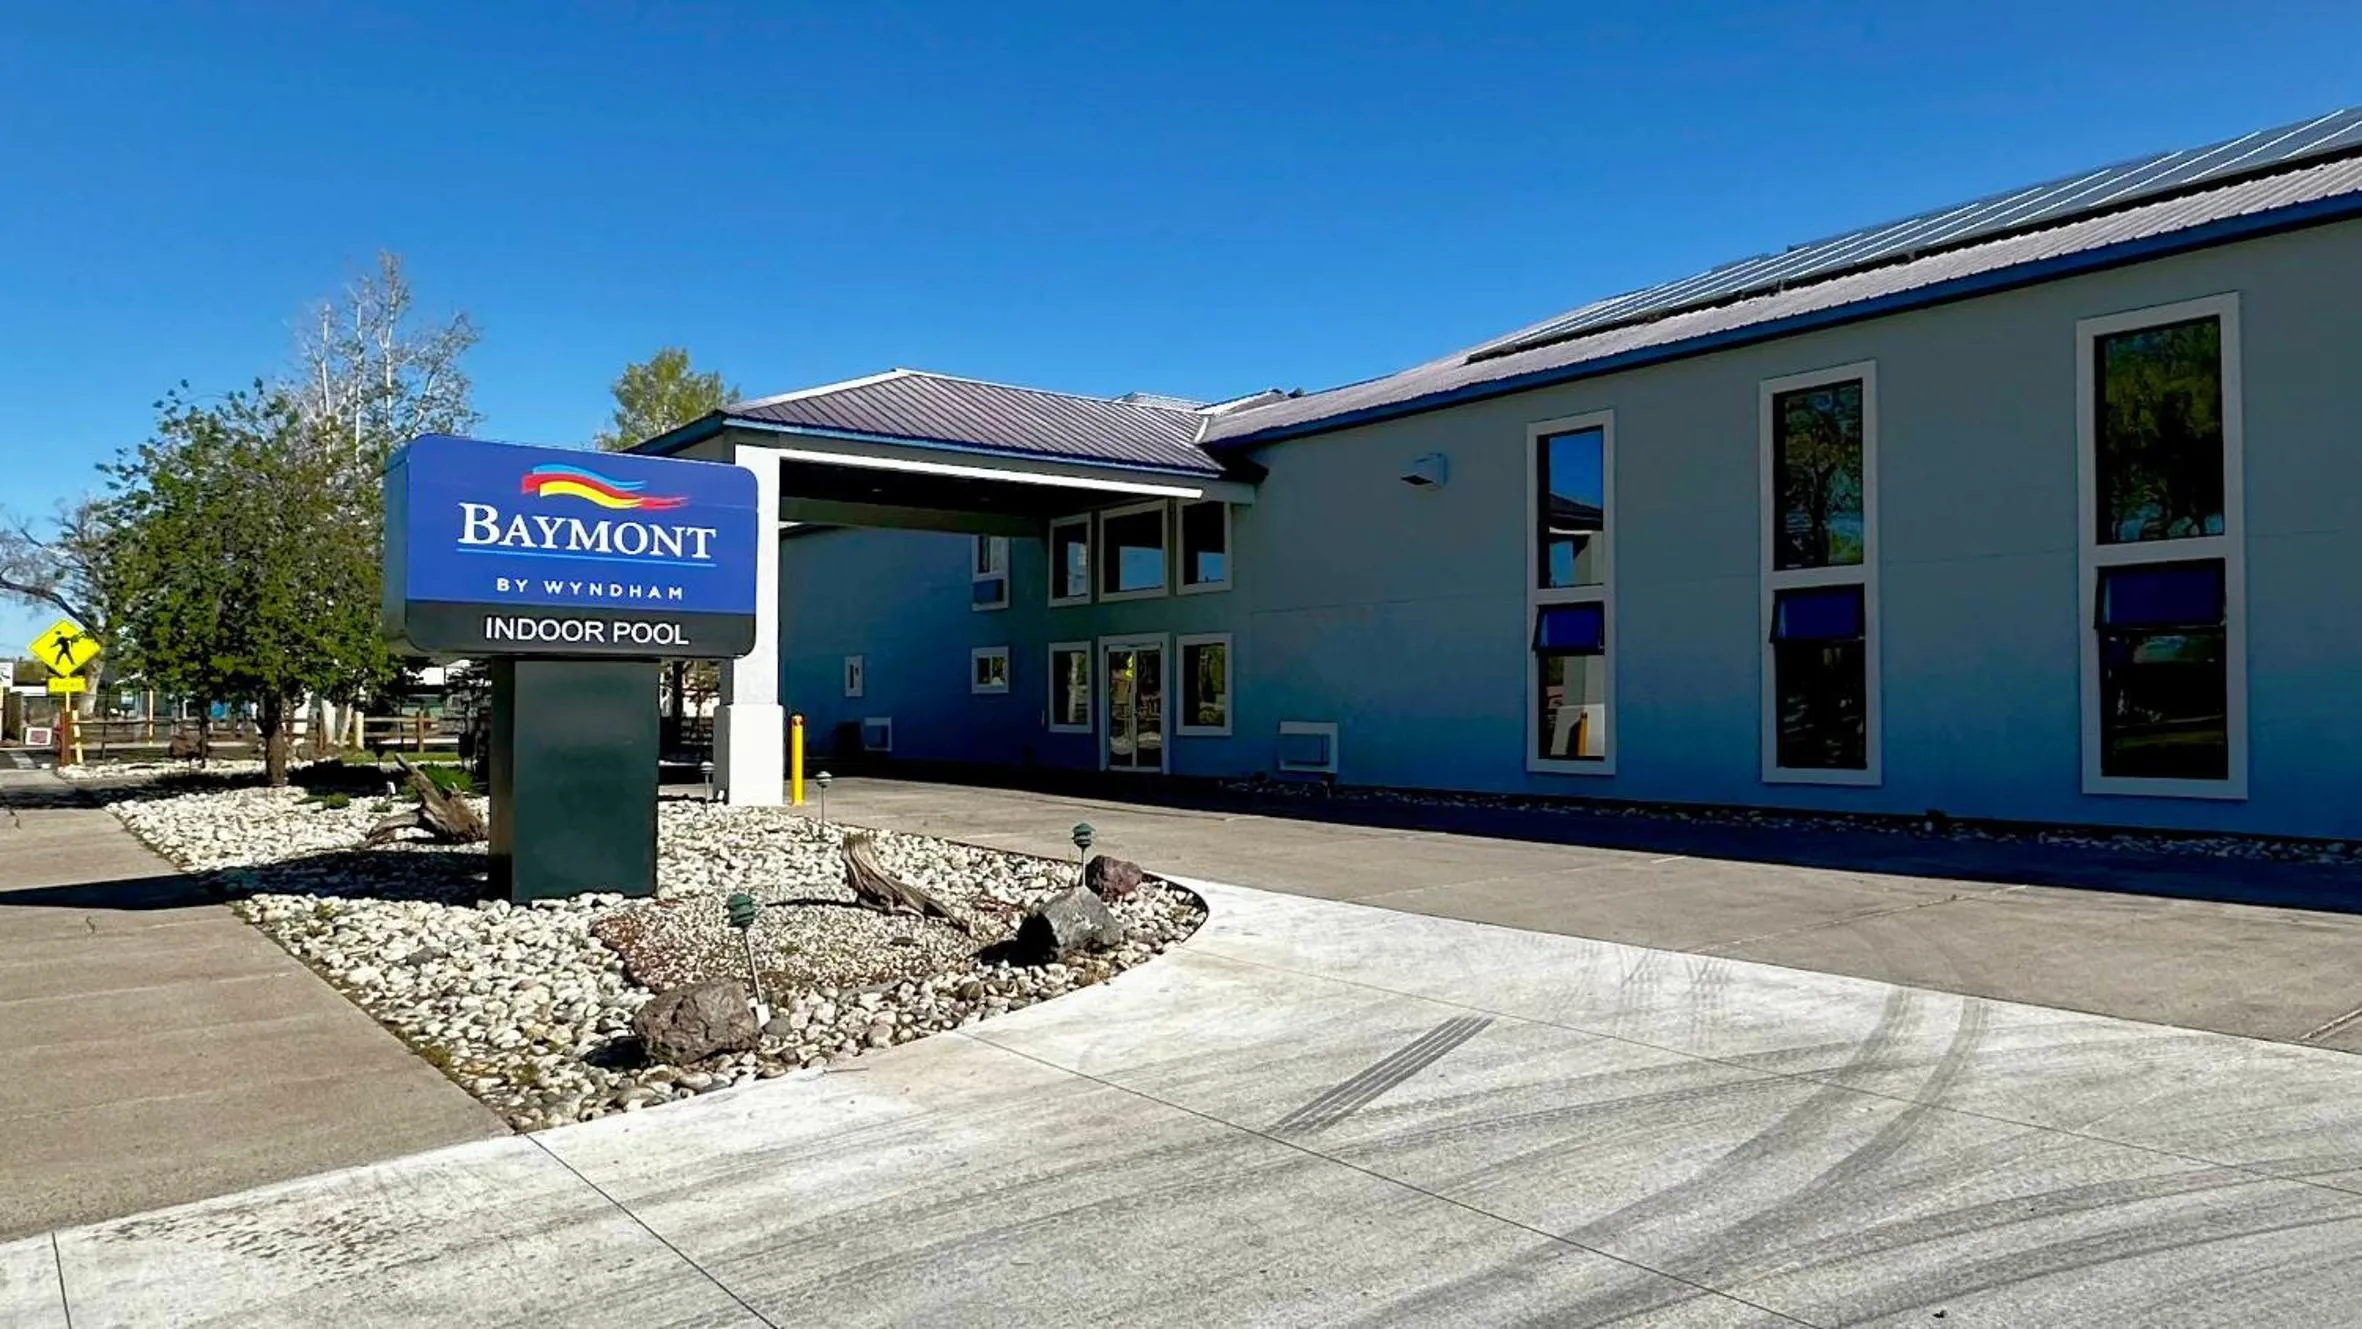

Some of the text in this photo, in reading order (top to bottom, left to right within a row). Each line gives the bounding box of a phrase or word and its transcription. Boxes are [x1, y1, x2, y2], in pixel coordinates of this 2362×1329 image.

[457, 502, 717, 559] BAYMONT
[497, 577, 683, 600] BY WYNDHAM
[485, 616, 690, 646] INDOOR POOL
